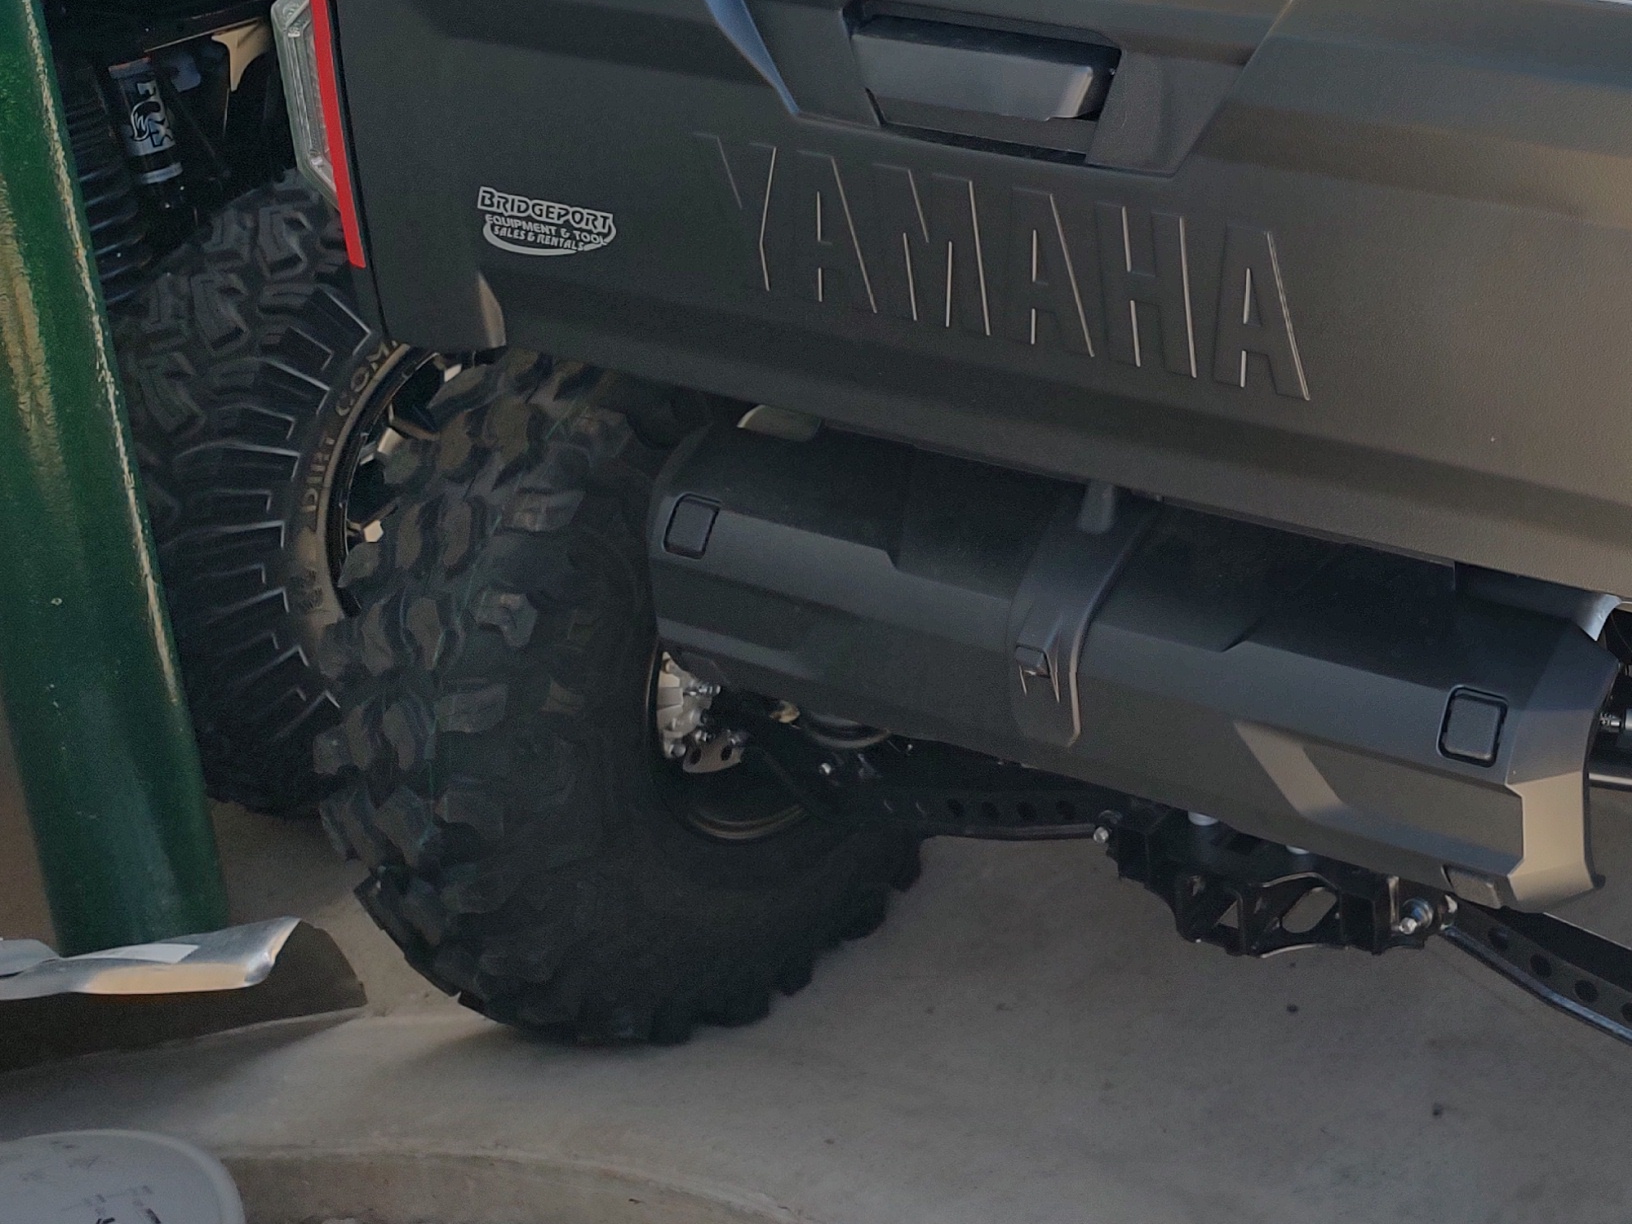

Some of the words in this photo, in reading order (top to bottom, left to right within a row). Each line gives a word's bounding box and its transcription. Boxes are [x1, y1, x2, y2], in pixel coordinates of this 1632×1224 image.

[131, 79, 177, 148] FOX
[478, 187, 614, 233] BRIDGEPORT
[485, 214, 557, 236] EQUIPMENT
[560, 228, 571, 238] &
[573, 231, 607, 246] TOOL
[494, 226, 526, 240] SALES
[527, 231, 535, 242] &
[536, 235, 585, 251] RENTALS
[693, 132, 1310, 401] YAMAHA
